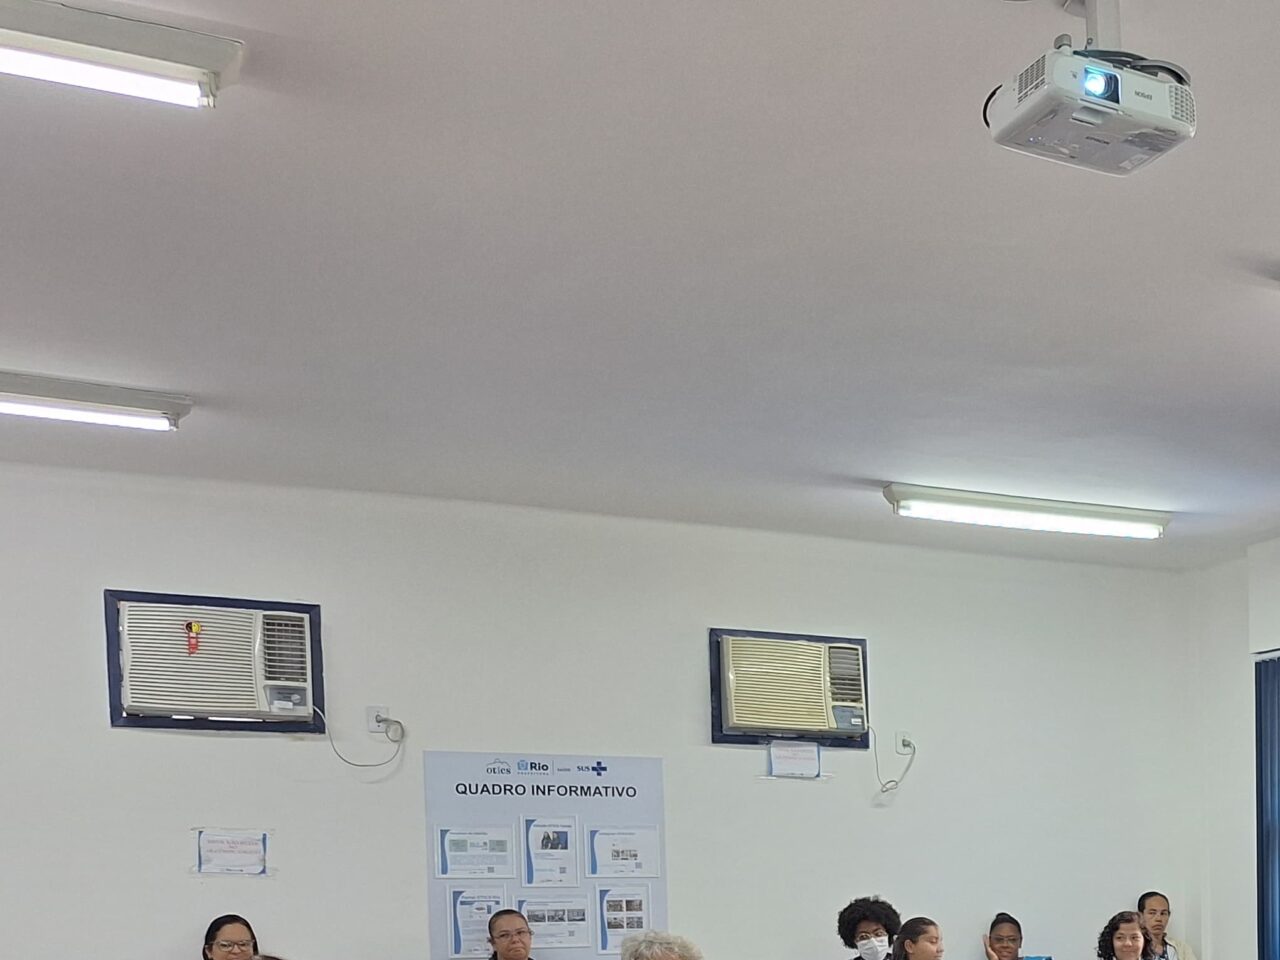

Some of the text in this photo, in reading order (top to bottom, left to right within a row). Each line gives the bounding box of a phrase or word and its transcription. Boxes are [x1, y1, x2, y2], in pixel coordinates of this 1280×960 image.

[486, 766, 512, 775] otics
[530, 762, 549, 771] Rio
[455, 783, 638, 798] QUADRO INFORMATIVO
